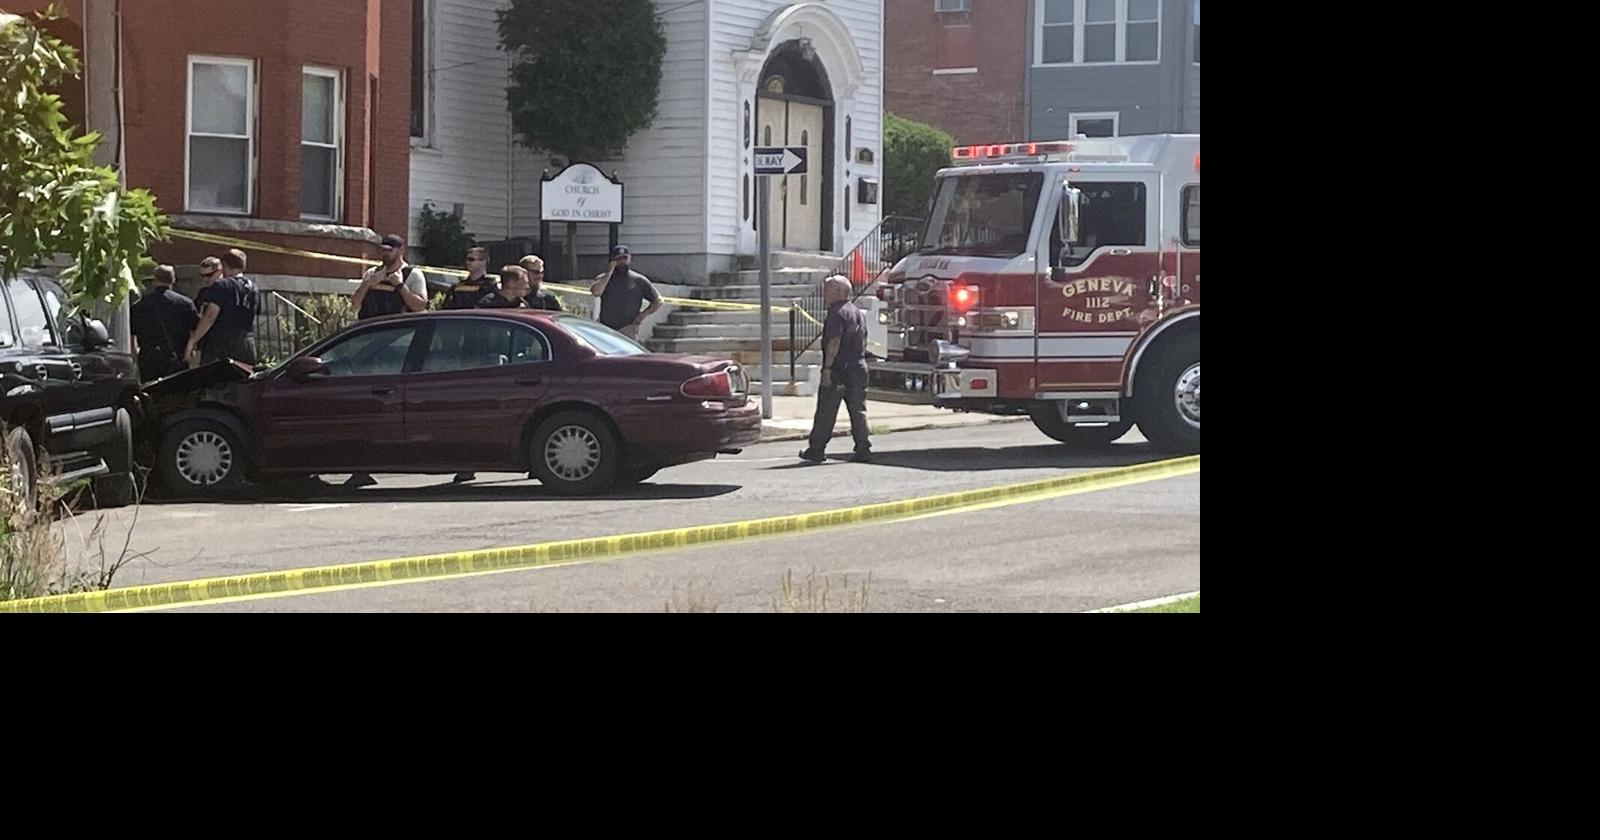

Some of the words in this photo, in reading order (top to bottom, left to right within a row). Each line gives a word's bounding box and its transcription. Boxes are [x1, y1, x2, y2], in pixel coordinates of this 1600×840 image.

[765, 155, 784, 166] WAY
[565, 185, 599, 194] CHURCH
[552, 208, 570, 217] GOD
[572, 209, 581, 217] IN
[583, 209, 612, 218] CHRIST
[1062, 279, 1134, 297] GENEVA
[1086, 296, 1110, 308] 1112
[1062, 307, 1092, 323] FIRE
